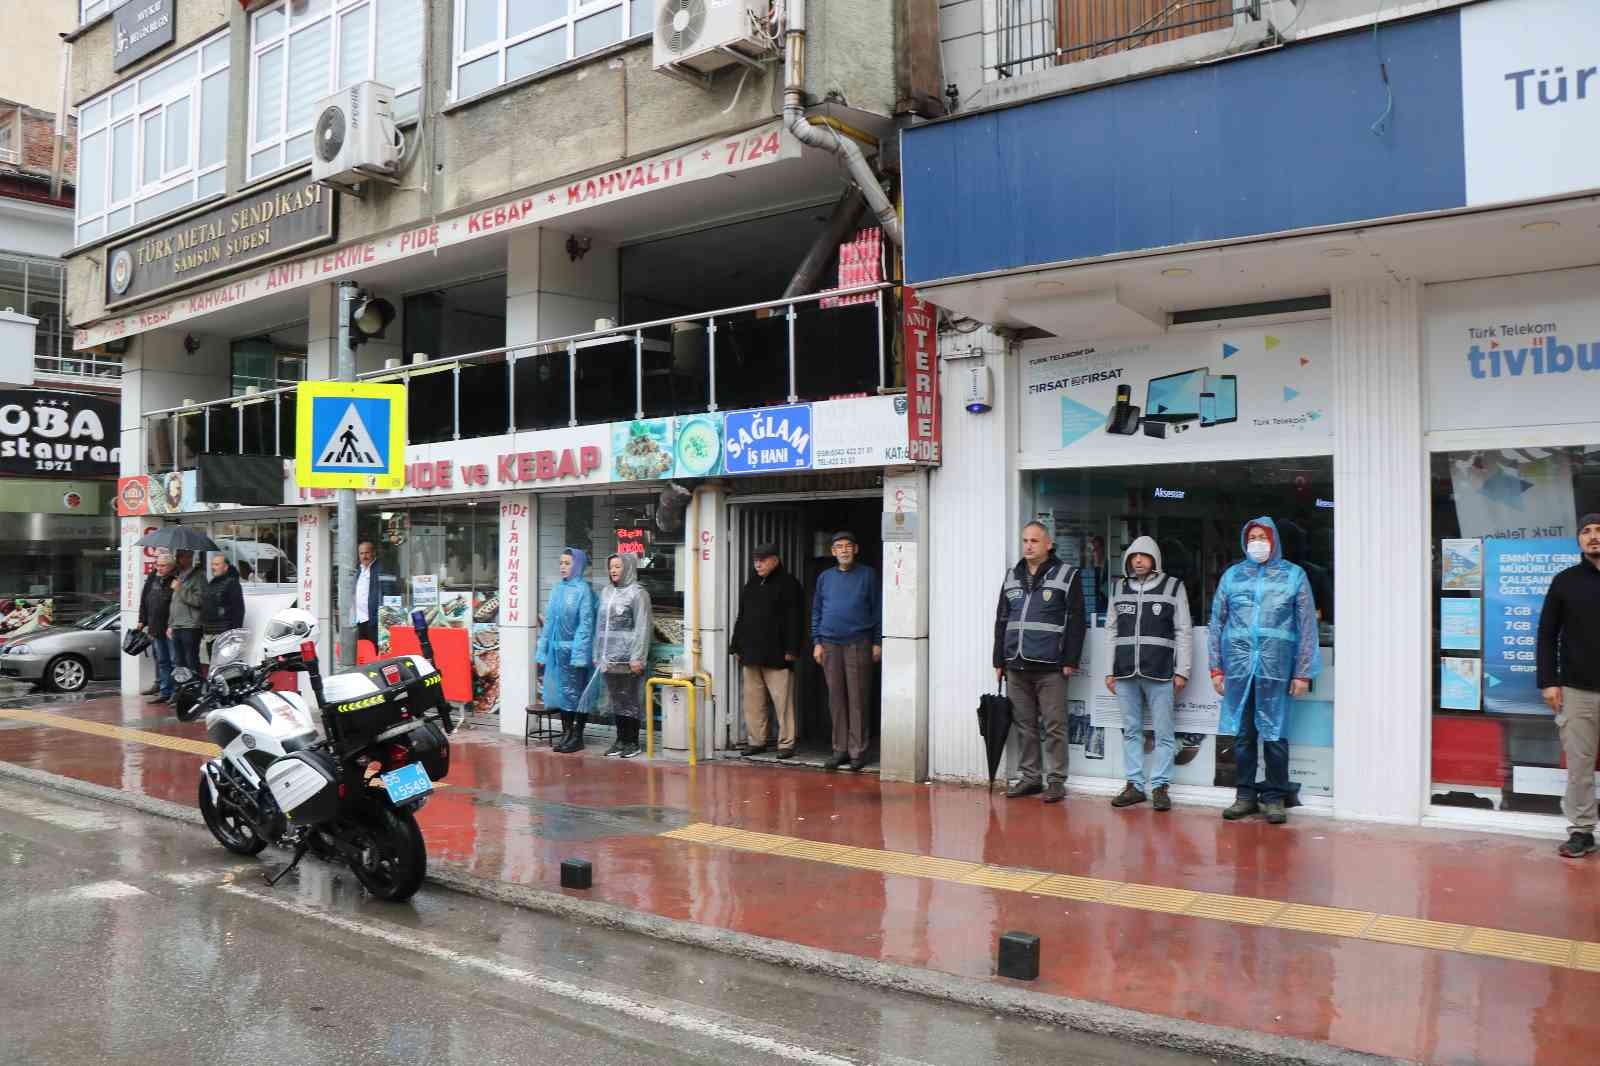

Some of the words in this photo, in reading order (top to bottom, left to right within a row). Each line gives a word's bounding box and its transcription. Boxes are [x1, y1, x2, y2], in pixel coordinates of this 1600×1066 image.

[1504, 66, 1598, 111] Tür
[189, 283, 247, 313] KAHVALTI
[313, 241, 376, 275] TERME
[467, 198, 534, 234] KEBAP
[566, 157, 685, 206] KAHVALTI
[726, 131, 780, 165] 7/24
[137, 237, 173, 267] TÜRK
[176, 219, 226, 250] METAL
[174, 246, 221, 273] SAMSUN
[1468, 326, 1496, 339] Türk
[1500, 321, 1557, 337] Telekom
[913, 329, 931, 437] TERME
[1029, 378, 1069, 395] FIRSAT
[1081, 368, 1124, 386] FIRSAT
[726, 412, 810, 459] SAĞLAM
[35, 460, 73, 472] 1971
[461, 464, 489, 486] ve
[497, 445, 600, 483] KEBAP
[747, 446, 758, 468] İŞ
[761, 447, 788, 464] HANI
[507, 519, 520, 622] LAHMACUN
[1504, 606, 1512, 616] 2
[1513, 606, 1532, 616] GB
[1504, 621, 1512, 631] 7
[1513, 621, 1531, 631] GB
[1503, 636, 1515, 645] 12
[1516, 636, 1535, 646] GB
[1516, 651, 1535, 661] GB
[398, 777, 428, 797] 5549
